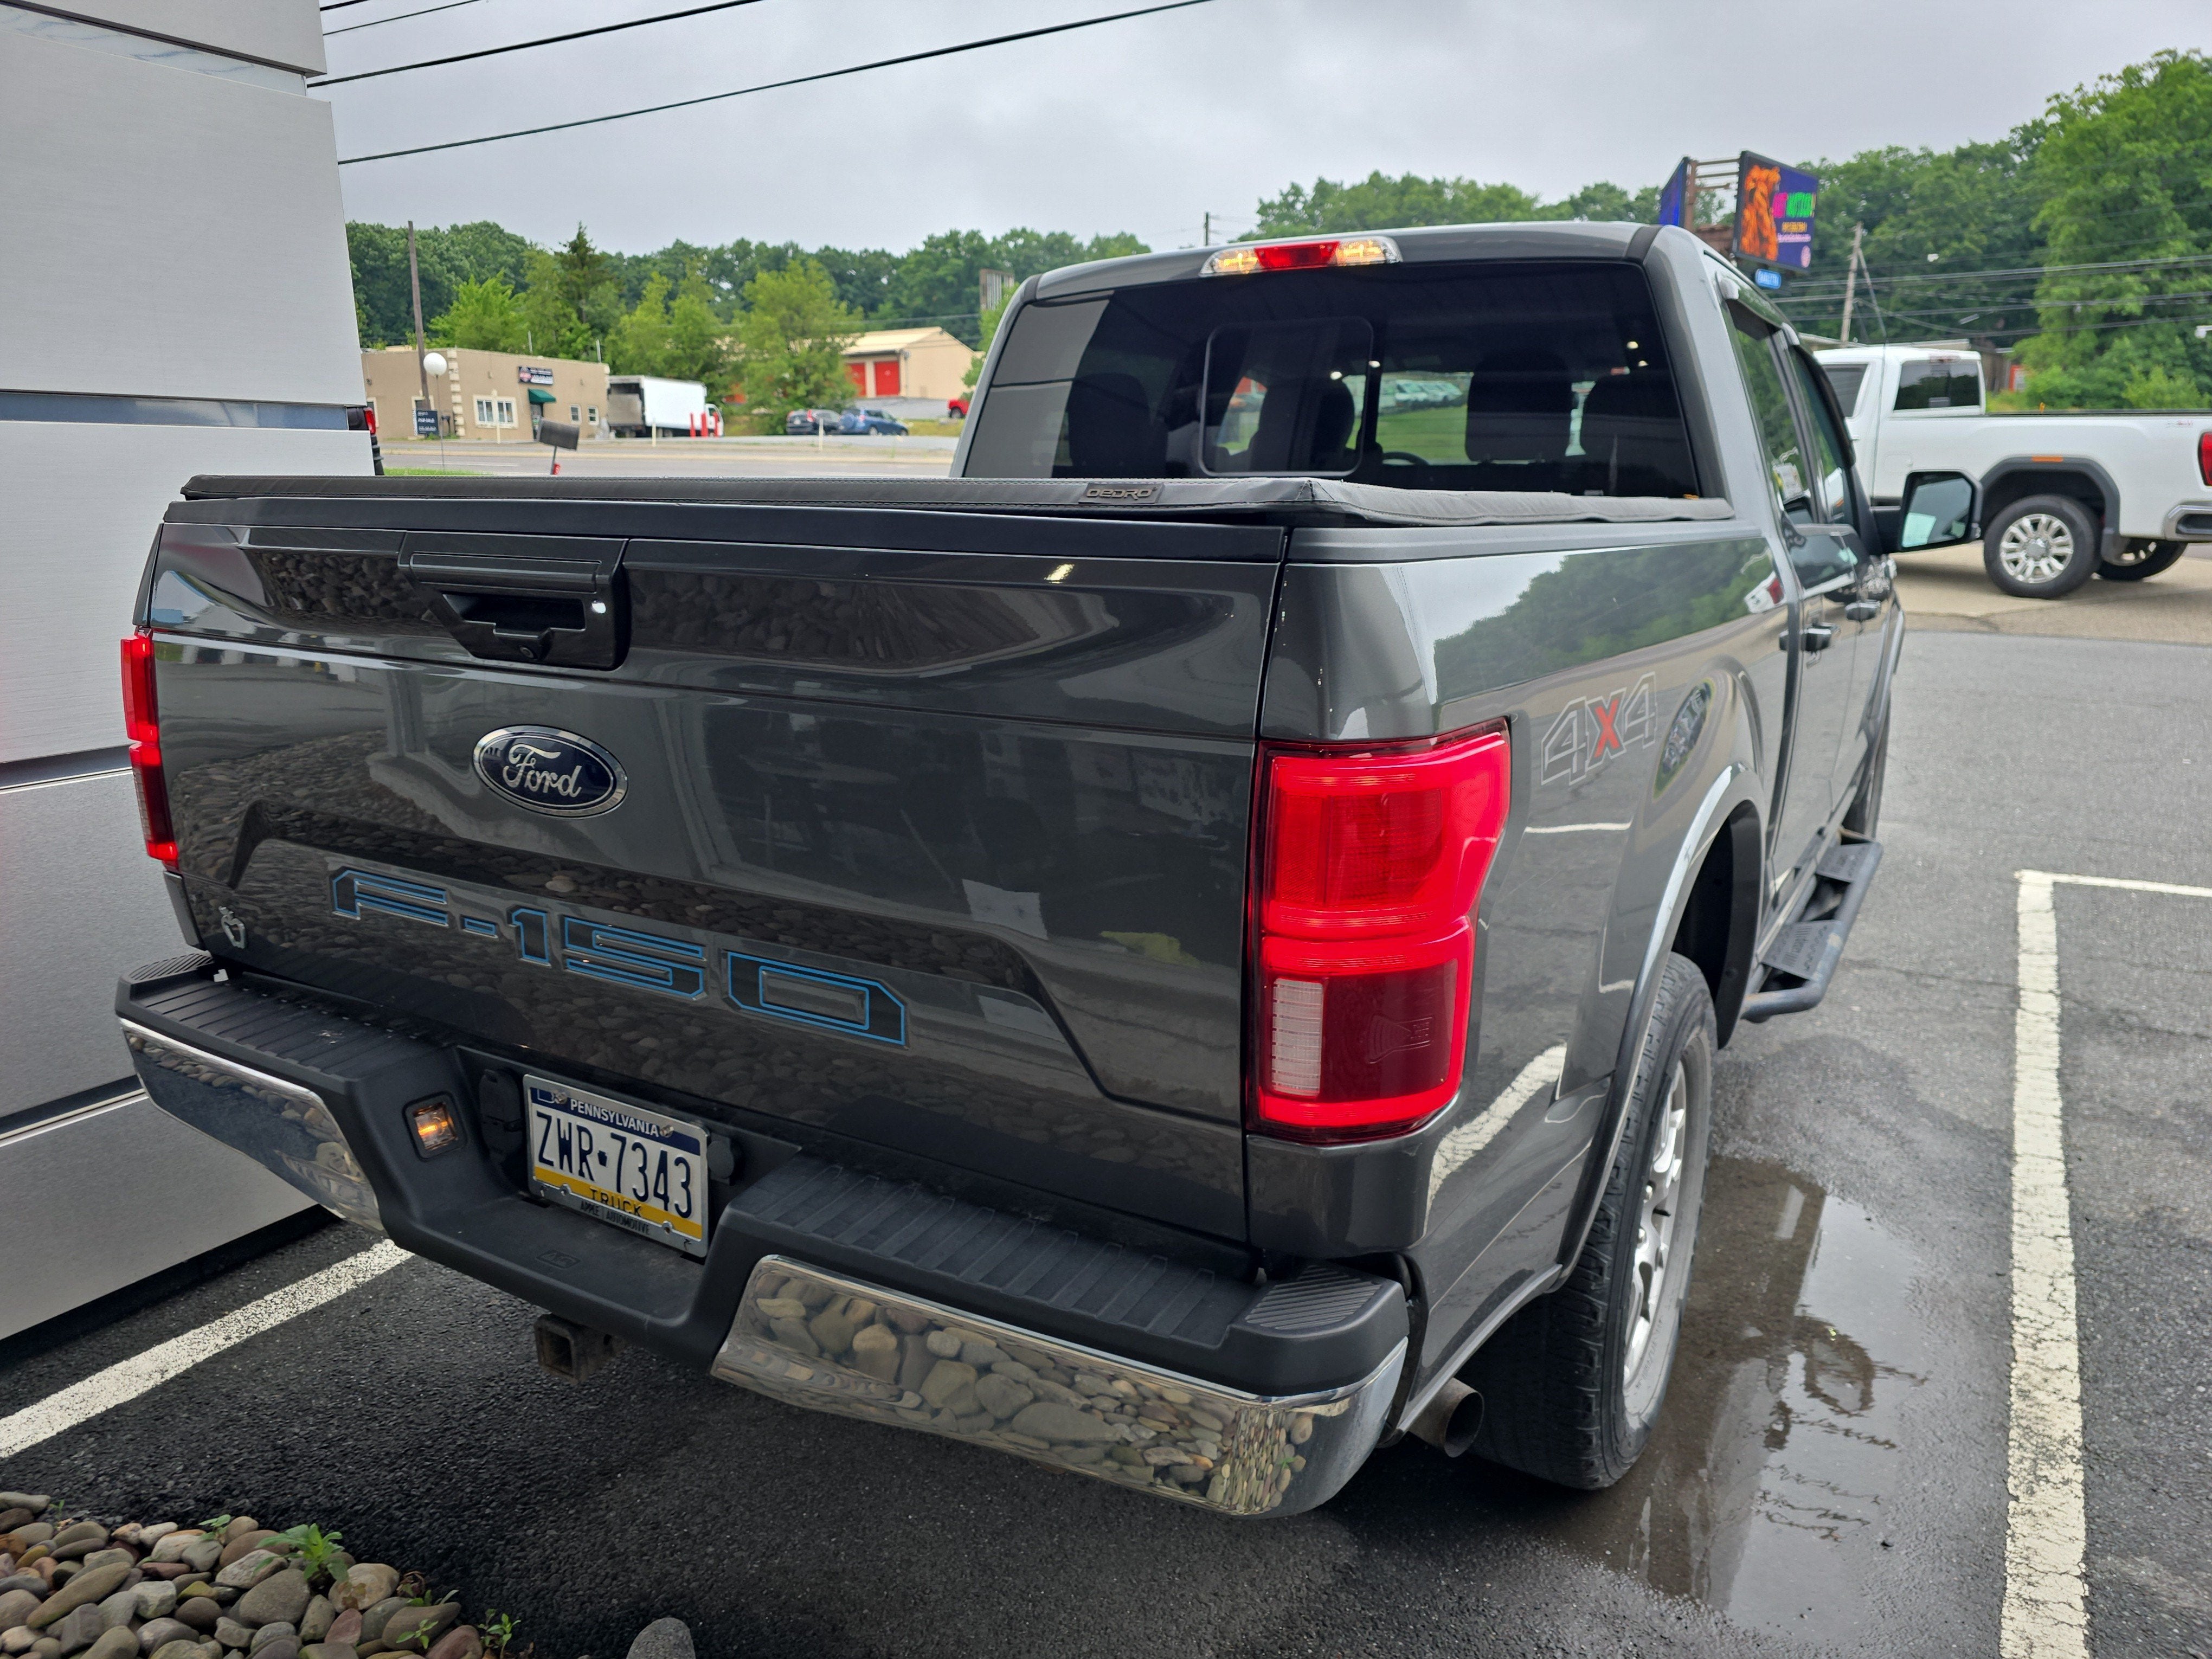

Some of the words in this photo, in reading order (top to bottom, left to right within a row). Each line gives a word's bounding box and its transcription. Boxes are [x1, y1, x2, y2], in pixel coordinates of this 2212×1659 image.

[503, 743, 583, 798] Ford
[332, 869, 907, 1047] F-150
[570, 1099, 659, 1137] PENNSYLVANIA
[580, 1200, 600, 1217] APPLE
[606, 1210, 651, 1236] AUTOMOTIVE
[590, 1187, 642, 1218] TRUCK
